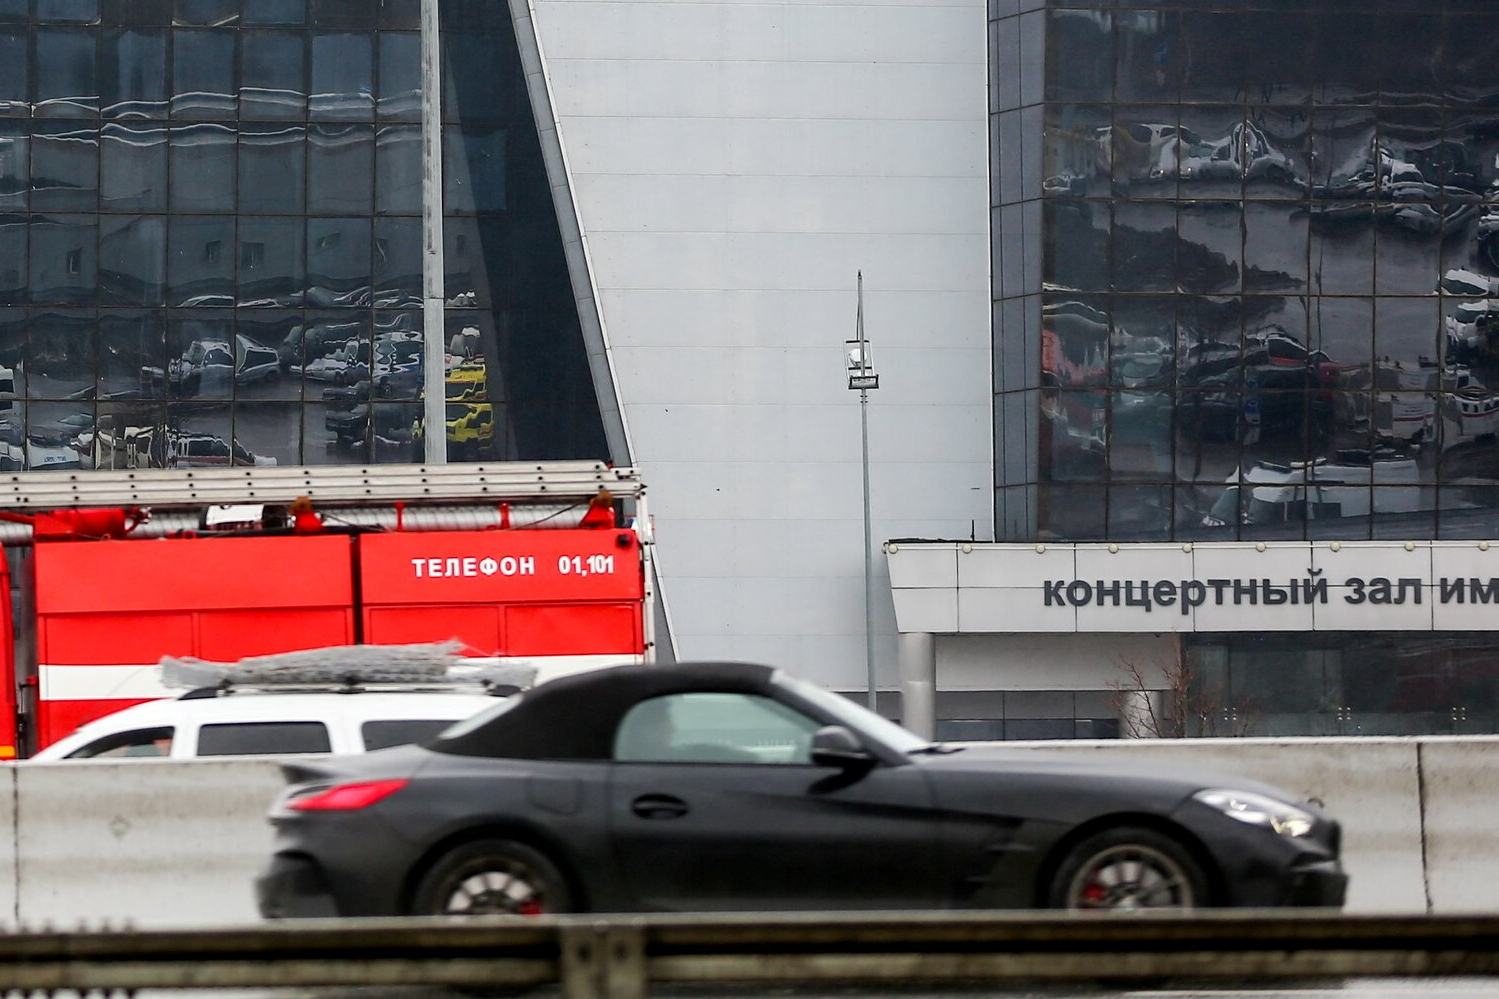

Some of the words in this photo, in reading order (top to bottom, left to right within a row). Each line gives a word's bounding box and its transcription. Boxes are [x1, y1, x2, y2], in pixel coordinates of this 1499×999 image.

[411, 556, 535, 578] ТЕЛЕФОН
[558, 555, 614, 576] 01,101
[1043, 568, 1328, 614] концертный
[1344, 577, 1422, 604] зал
